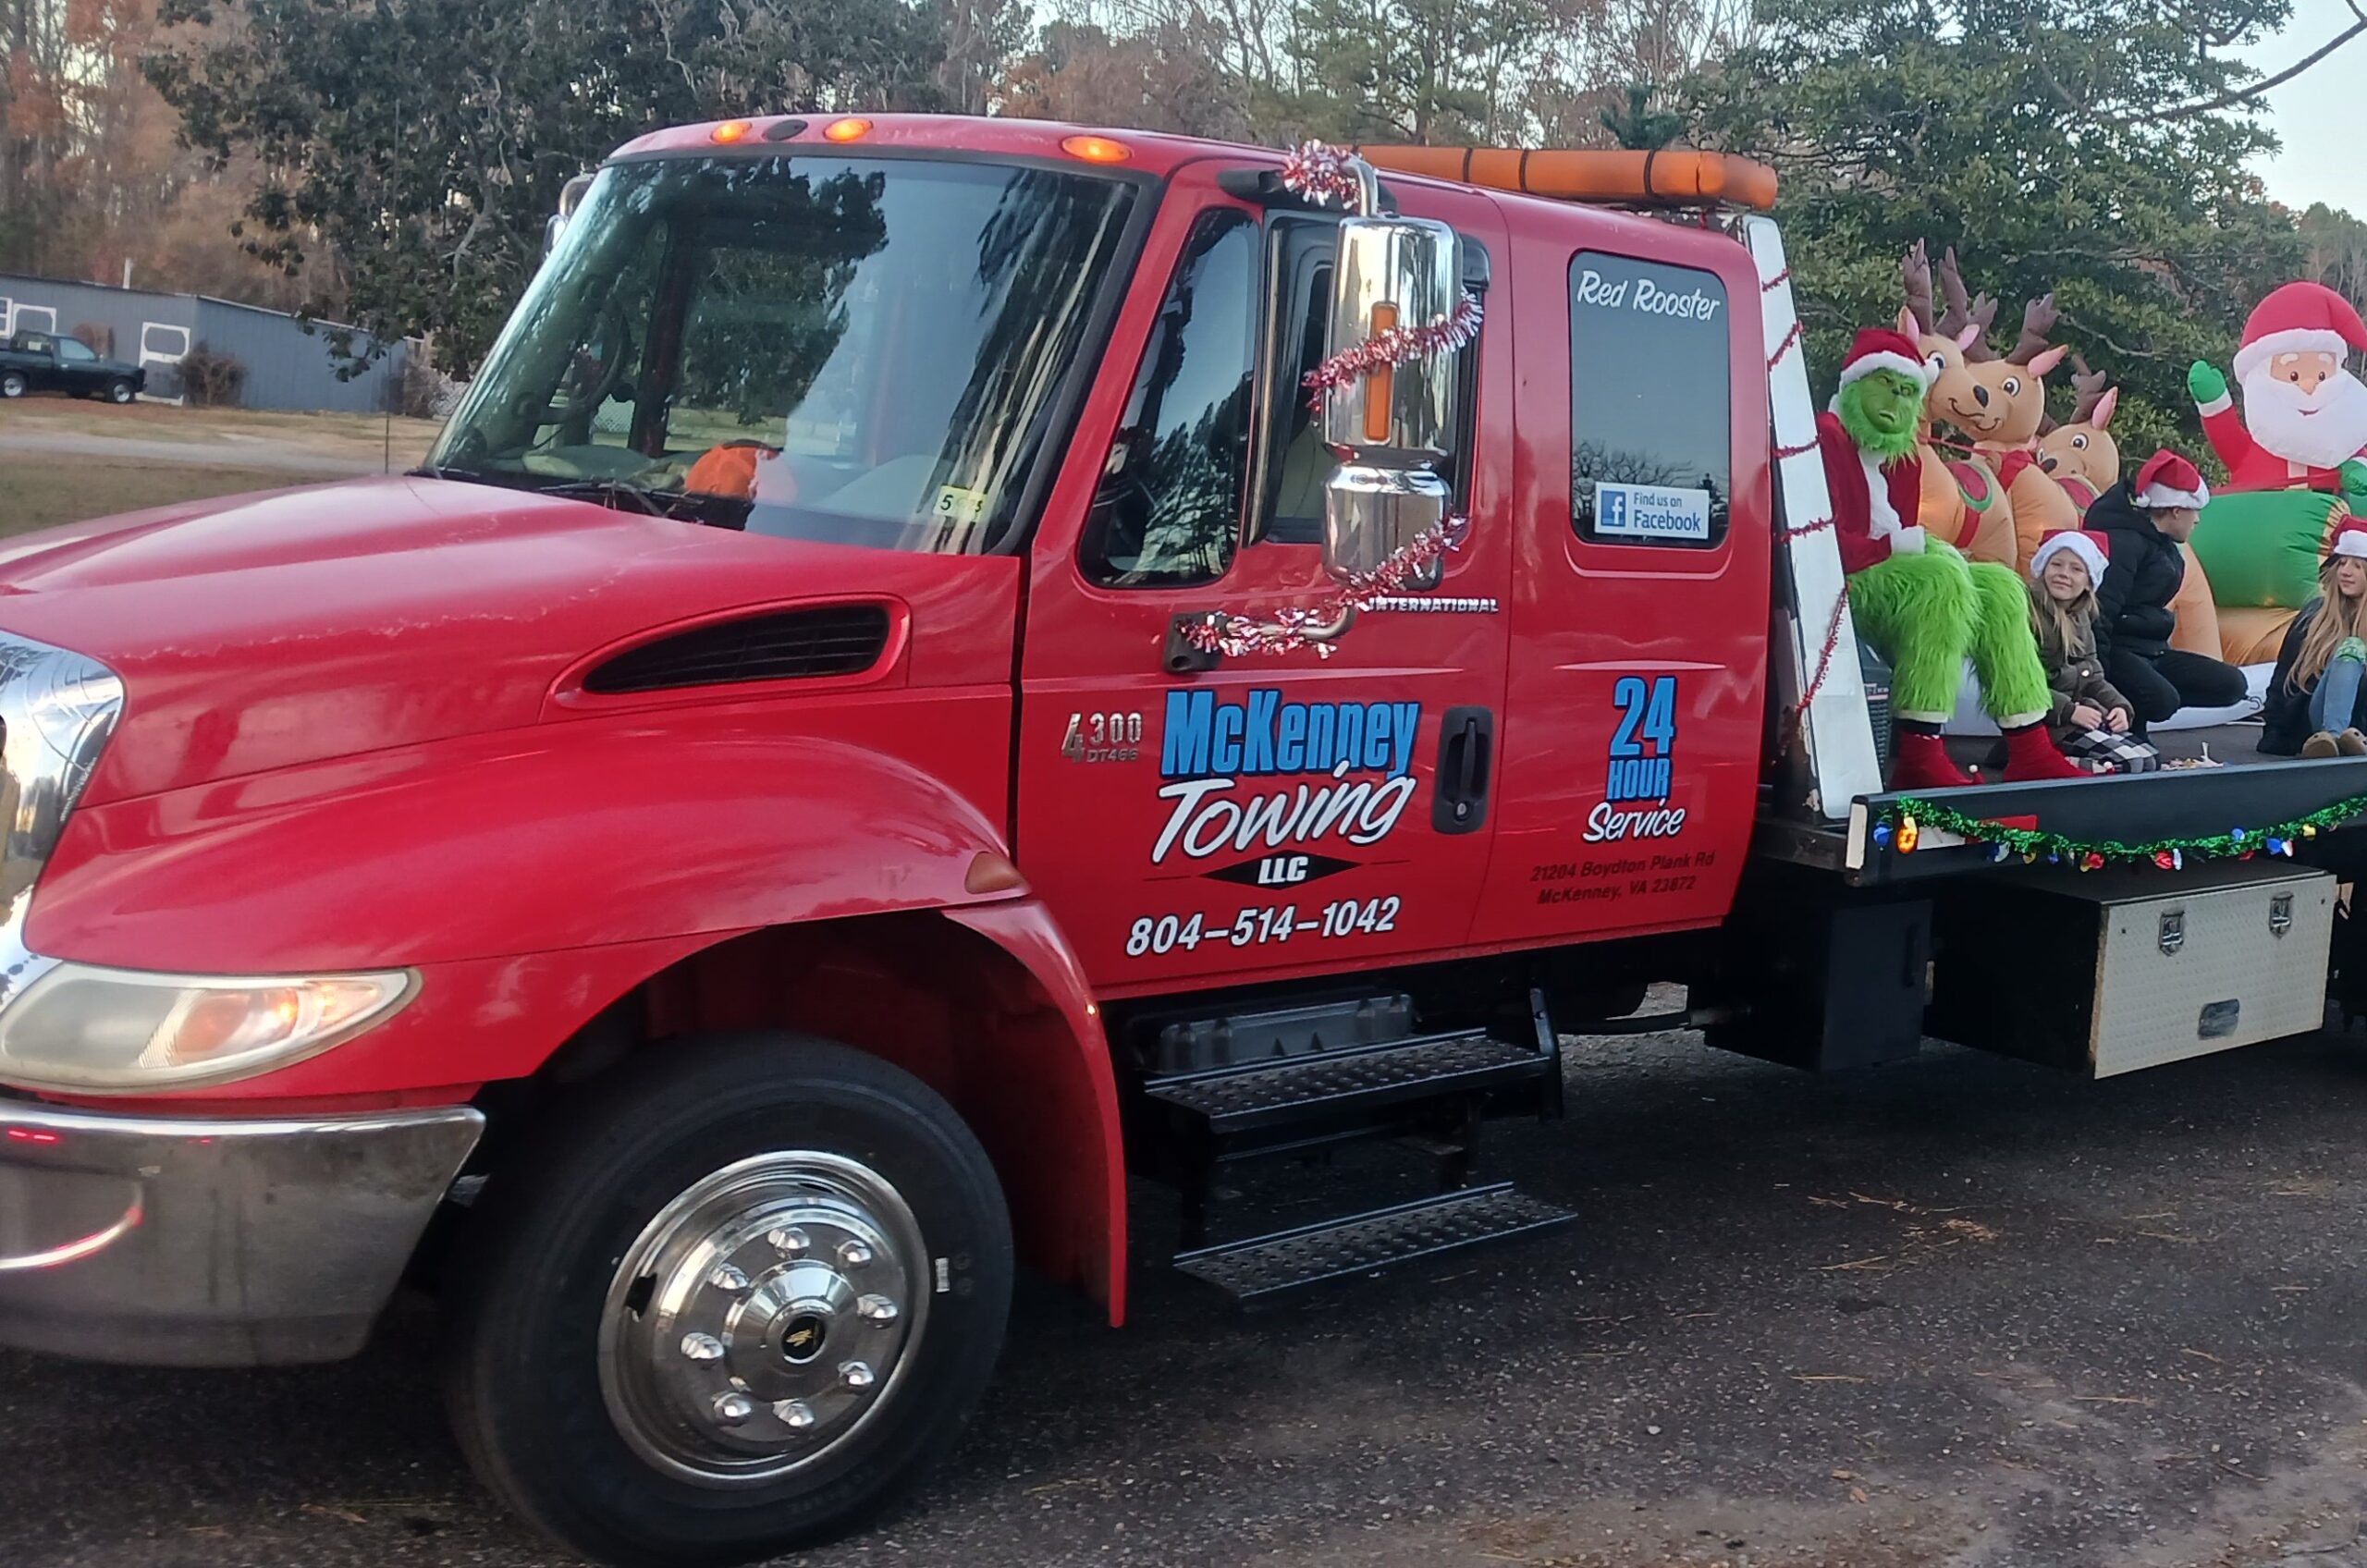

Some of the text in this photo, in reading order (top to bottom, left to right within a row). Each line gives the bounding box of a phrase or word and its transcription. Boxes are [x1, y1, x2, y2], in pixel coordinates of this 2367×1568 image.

[1576, 270, 1721, 321] Red Rooster
[1634, 492, 1682, 508] Find us on
[1634, 509, 1701, 532] Facebook
[1368, 596, 1499, 612] INTERNATIONAL
[1061, 712, 1142, 763] 4300
[1161, 689, 1421, 779] McKenney
[1609, 675, 1677, 756] 24
[1605, 757, 1672, 802] HOUR
[1151, 760, 1417, 864] Towing
[1582, 798, 1686, 843] Service
[1257, 856, 1308, 884] LLC
[1650, 853, 1691, 871] Plank
[1695, 851, 1716, 866] Rd
[1537, 885, 1623, 905] McKenney,
[1629, 880, 1648, 895] VA
[1125, 896, 1402, 957] 804-514-1042
